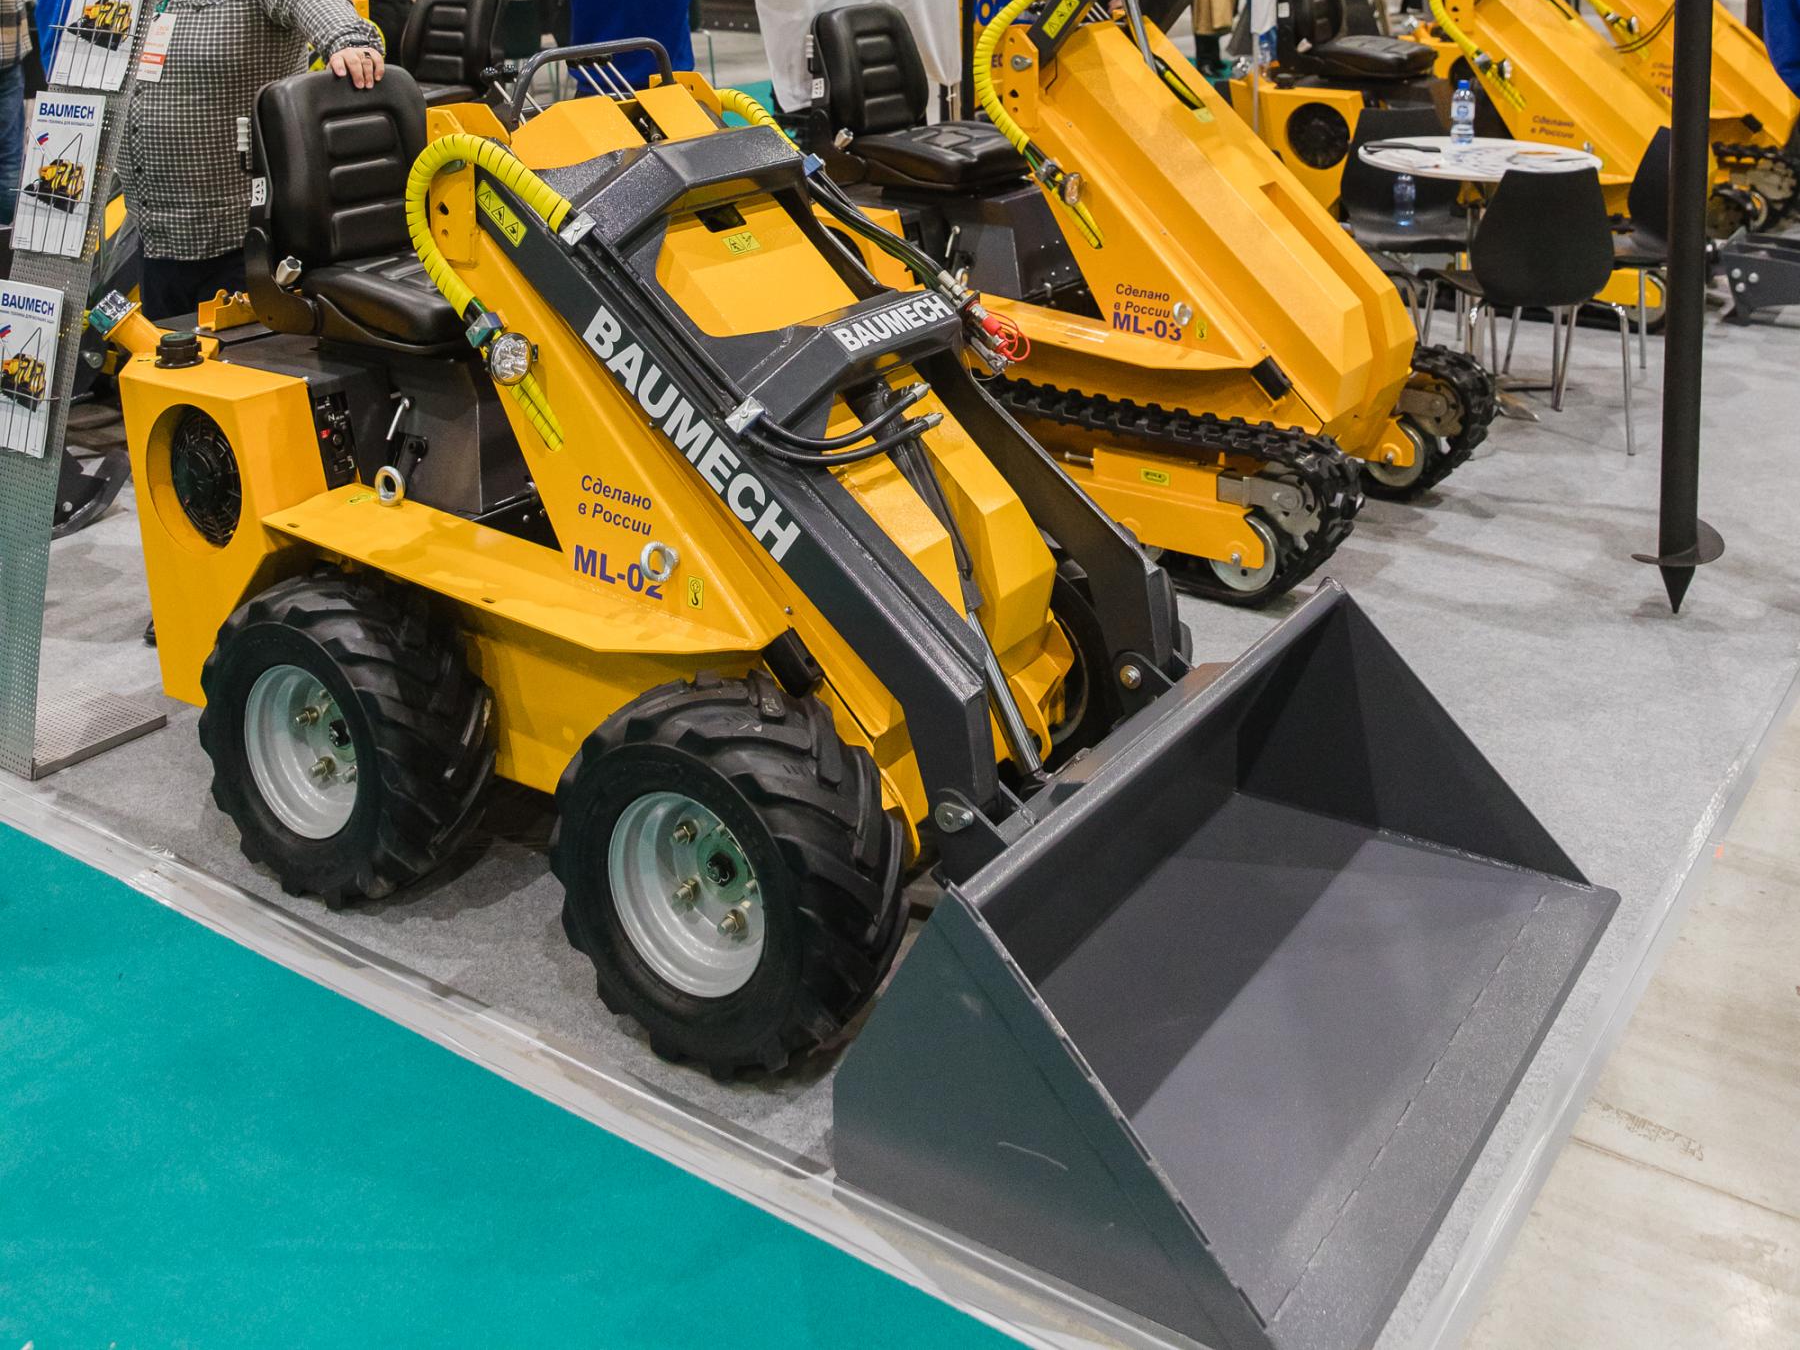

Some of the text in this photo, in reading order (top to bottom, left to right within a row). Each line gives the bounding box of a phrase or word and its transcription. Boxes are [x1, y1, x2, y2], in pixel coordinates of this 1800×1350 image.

[38, 102, 96, 120] BAUMECH
[1, 293, 55, 317] BAUMECH
[1115, 283, 1170, 302] Сделано
[832, 296, 953, 352] BAUMECH
[1114, 301, 1170, 318] в России
[1112, 311, 1182, 341] ML-03
[582, 305, 801, 562] BAUMECH
[581, 475, 652, 510] Сделано
[578, 502, 652, 536] в России
